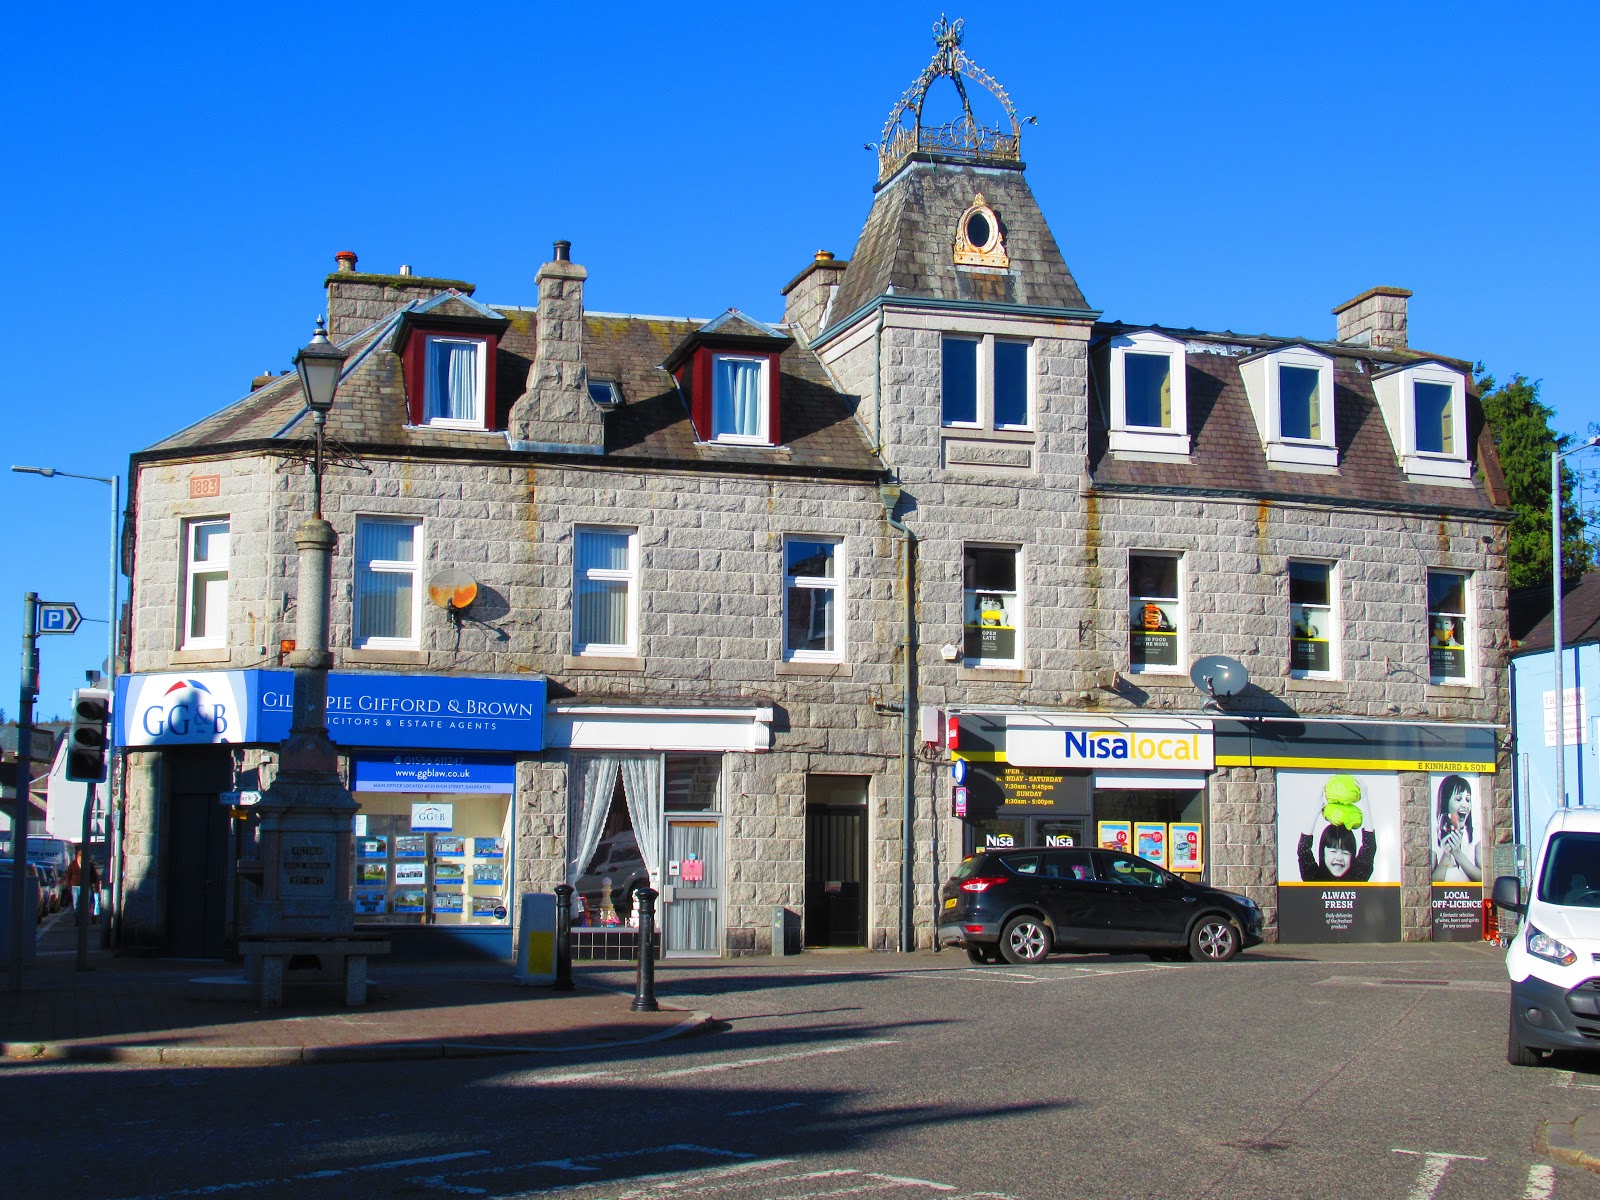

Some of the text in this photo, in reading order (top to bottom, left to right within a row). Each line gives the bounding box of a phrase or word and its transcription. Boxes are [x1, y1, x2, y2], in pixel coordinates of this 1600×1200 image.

[192, 480, 216, 494] 1883
[48, 612, 61, 627] P
[263, 691, 532, 716] GILPIE GIFFORD & BROWN
[143, 703, 228, 737] GG&B
[327, 717, 497, 730] ICITORS & ESTATE AGENTS
[404, 756, 433, 765] 01556
[395, 768, 470, 780] www.ggblaw.co.uk
[986, 834, 1014, 846] Nisa
[1046, 834, 1073, 847] Nisa
[1321, 891, 1356, 899] ALWAYS
[1444, 891, 1469, 899] LOCAL
[1325, 900, 1353, 908] FRESH
[1432, 900, 1482, 908] OFF-LICENCE
